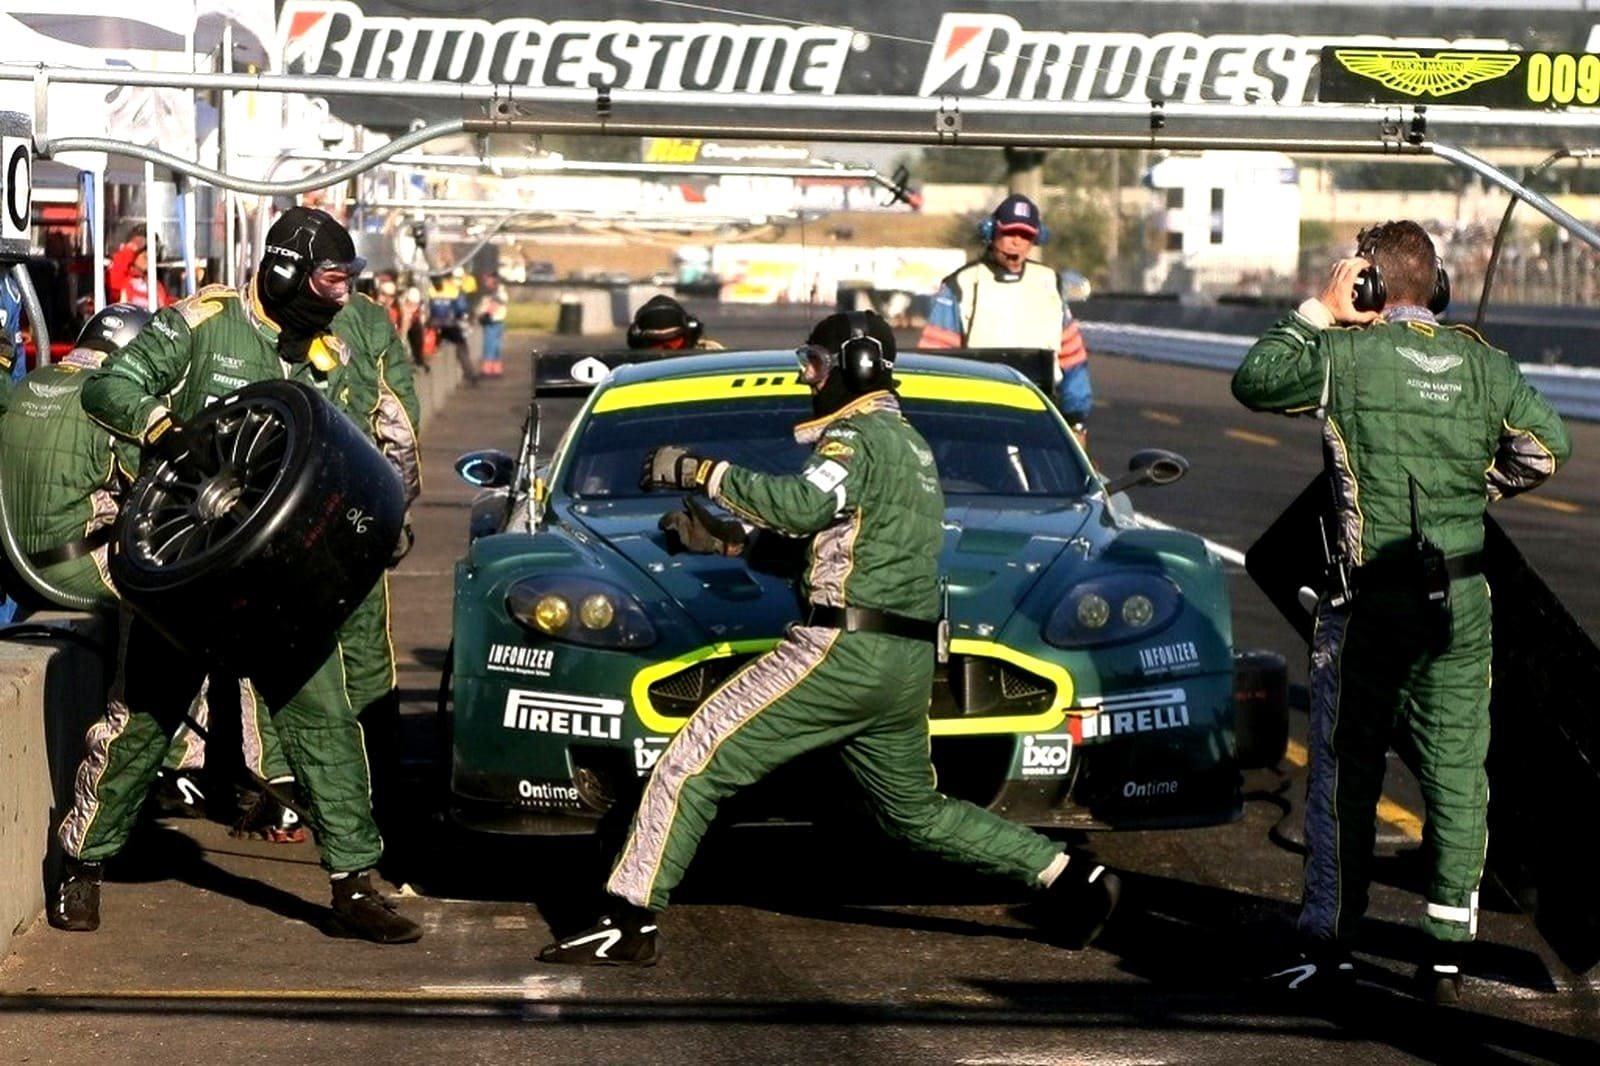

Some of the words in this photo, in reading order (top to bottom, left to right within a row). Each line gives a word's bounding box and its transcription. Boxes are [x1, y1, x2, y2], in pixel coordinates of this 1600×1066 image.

[285, 10, 836, 93] BRIDGESTONE
[1391, 60, 1423, 70] ASTON
[1427, 62, 1464, 71] MARTIN
[1527, 52, 1600, 104] 009
[1432, 382, 1462, 392] MARTIN
[488, 644, 554, 669] INFONIZER
[1139, 642, 1198, 668] INFONIZER
[503, 689, 624, 739] PIRELLI
[1080, 688, 1190, 739] PIRELLI
[519, 779, 579, 800] Ontime
[1122, 779, 1179, 798] Ontime
